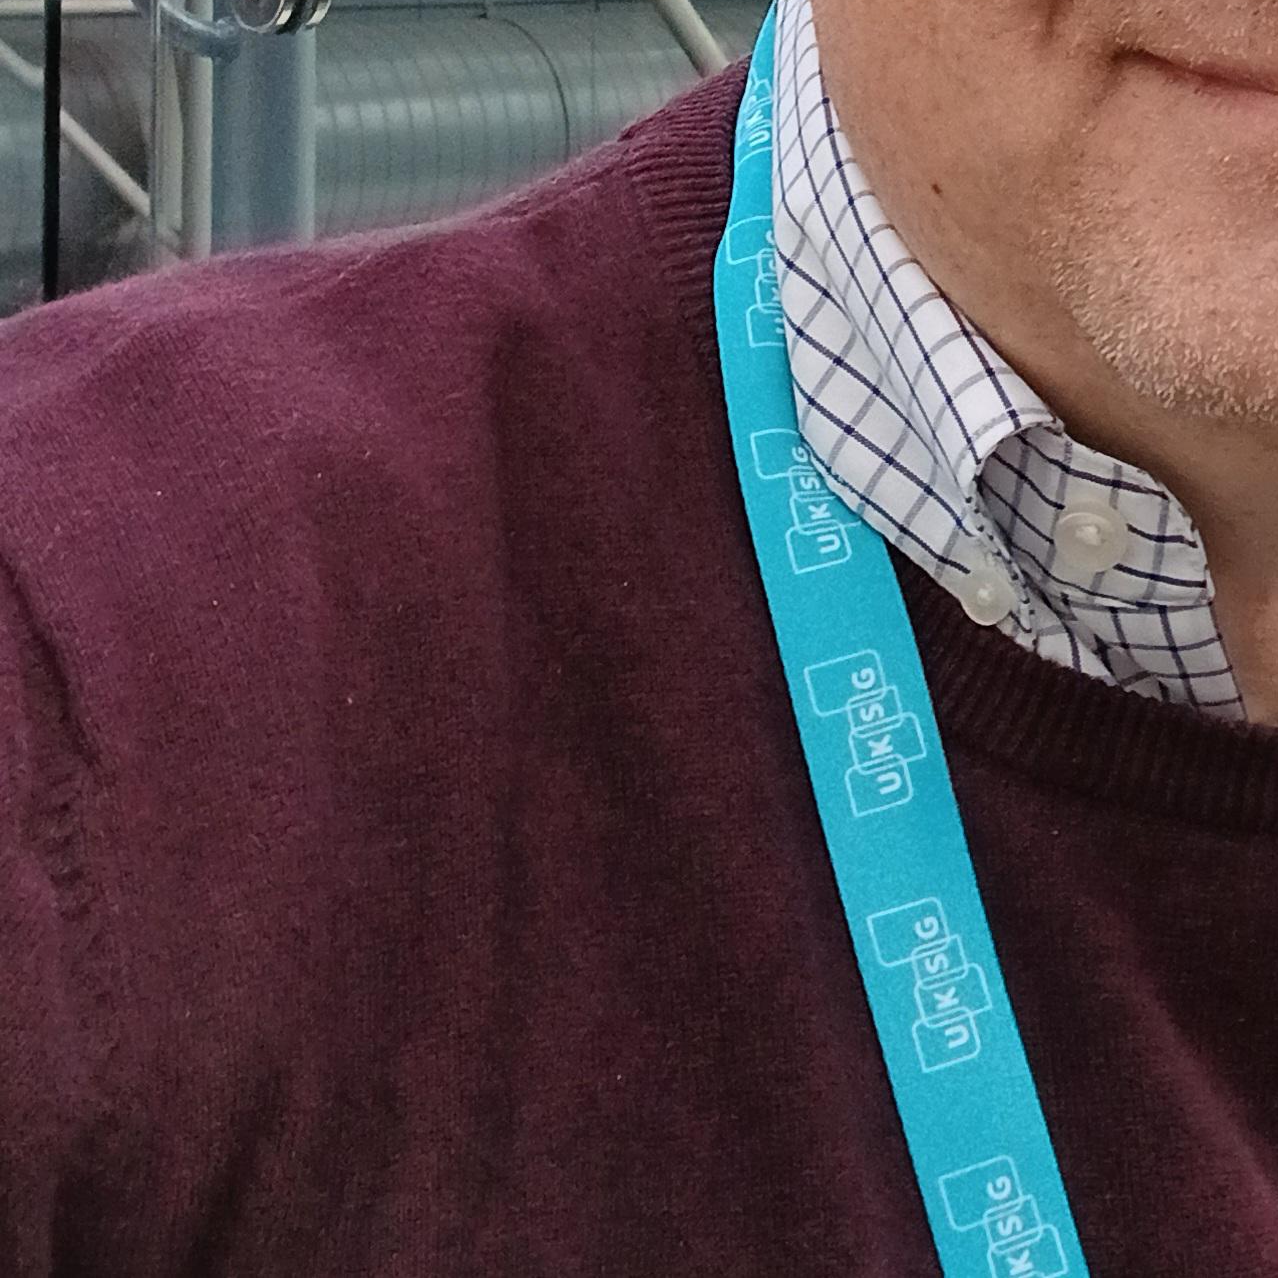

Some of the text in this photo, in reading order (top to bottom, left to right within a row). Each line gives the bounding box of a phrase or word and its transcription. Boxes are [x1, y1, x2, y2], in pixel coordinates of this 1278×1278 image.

[792, 446, 842, 554] UKSG
[851, 667, 902, 795] UKSG
[914, 916, 970, 1049] UKSG
[986, 1176, 1034, 1277] KSG
